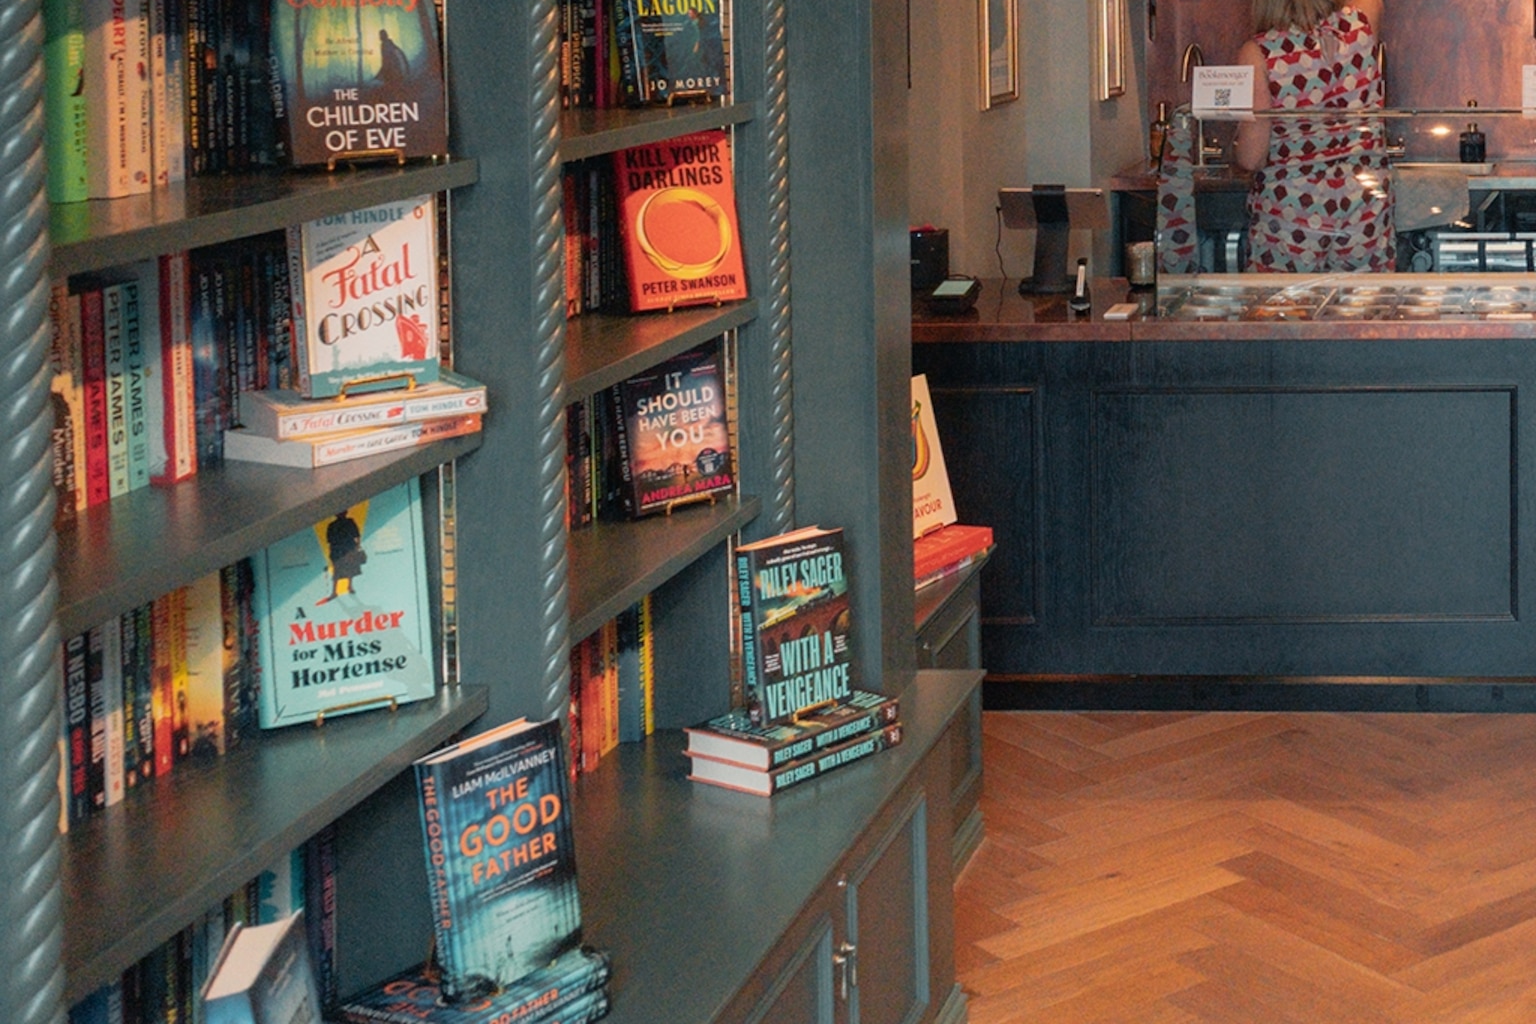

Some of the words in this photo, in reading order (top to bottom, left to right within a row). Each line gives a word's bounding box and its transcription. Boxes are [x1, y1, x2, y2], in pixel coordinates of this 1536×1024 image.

[334, 88, 359, 101] THE
[650, 79, 668, 92] JO
[674, 76, 722, 91] MOREY
[307, 102, 420, 127] CHILDREN
[326, 129, 358, 151] OF
[367, 126, 407, 150] EVE
[625, 149, 666, 170] KILL
[668, 143, 721, 166] YOUR
[628, 165, 724, 191] DARLINGS
[314, 212, 347, 228] TOM
[352, 206, 405, 225] HINDLE
[361, 233, 381, 258] A
[321, 242, 418, 309] Fatal
[642, 279, 678, 296] PETER
[681, 273, 737, 292] SWANSON
[109, 291, 123, 365] PETER
[126, 284, 141, 358] PETER
[318, 284, 429, 346] CROSSING
[665, 371, 682, 391] IT
[112, 372, 126, 447] JAMES
[131, 364, 147, 437] JAMES
[410, 403, 429, 414] TOM
[431, 399, 464, 412] HINDLE
[637, 385, 714, 416] SHOULD
[301, 415, 335, 432] Fatal
[411, 427, 428, 439] TOM
[429, 421, 459, 435] HINDLE
[639, 413, 679, 433] HAVE
[681, 404, 717, 424] BEEN
[656, 425, 705, 451] YOU
[642, 483, 693, 504] ANDREA
[694, 474, 731, 493] MARA
[759, 562, 798, 601] RILEY
[800, 552, 843, 589] SAGER
[289, 610, 404, 646] Murder
[295, 606, 306, 620] A
[292, 648, 318, 662] for
[323, 639, 382, 663] Miss
[780, 633, 821, 678] WITH
[823, 629, 836, 665] A
[291, 654, 407, 689] Hortense
[765, 661, 851, 721] VENGEANCE
[792, 738, 814, 758] SAGER
[839, 716, 873, 739] VENGEANCE
[795, 762, 816, 782] SAGER
[841, 739, 876, 763] VENGEANCE
[423, 776, 437, 806] THE
[452, 775, 484, 799] LIAM
[486, 776, 529, 811] THE
[426, 808, 446, 866] GOOD
[460, 793, 561, 858] GOOD
[471, 832, 557, 885] FATHER
[436, 869, 452, 930] FATHER
